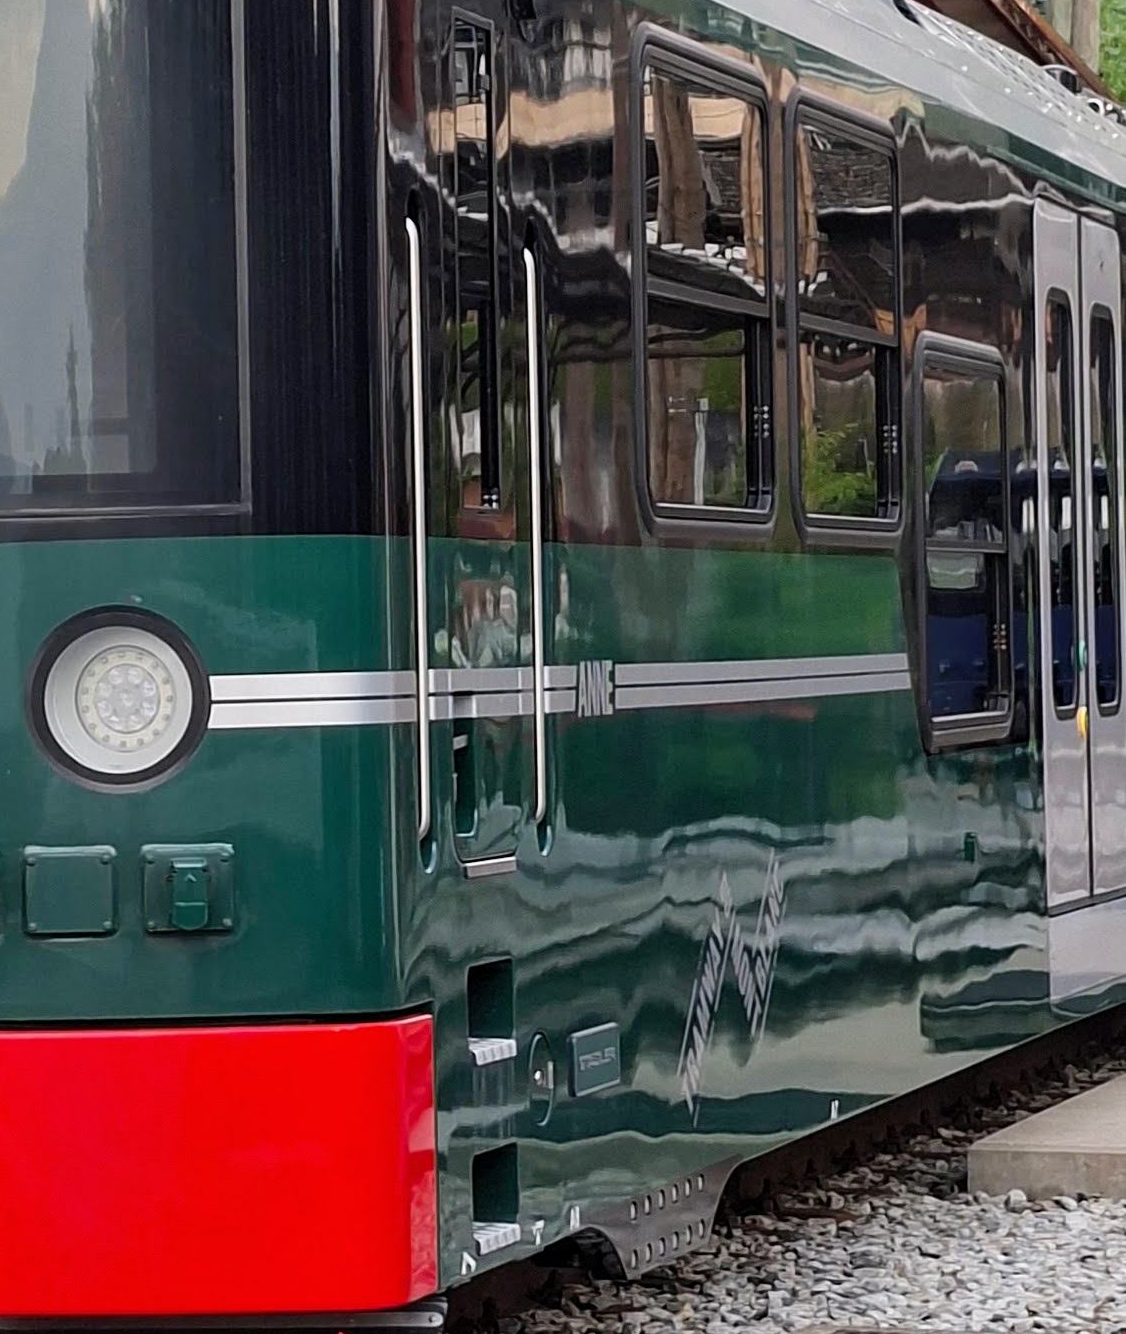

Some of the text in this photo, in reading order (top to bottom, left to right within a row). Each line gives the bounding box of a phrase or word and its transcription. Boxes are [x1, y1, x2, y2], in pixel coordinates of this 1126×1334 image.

[578, 659, 613, 718] ANNE
[682, 909, 724, 1115] TRAMWAY
[731, 923, 762, 1037] MONT
